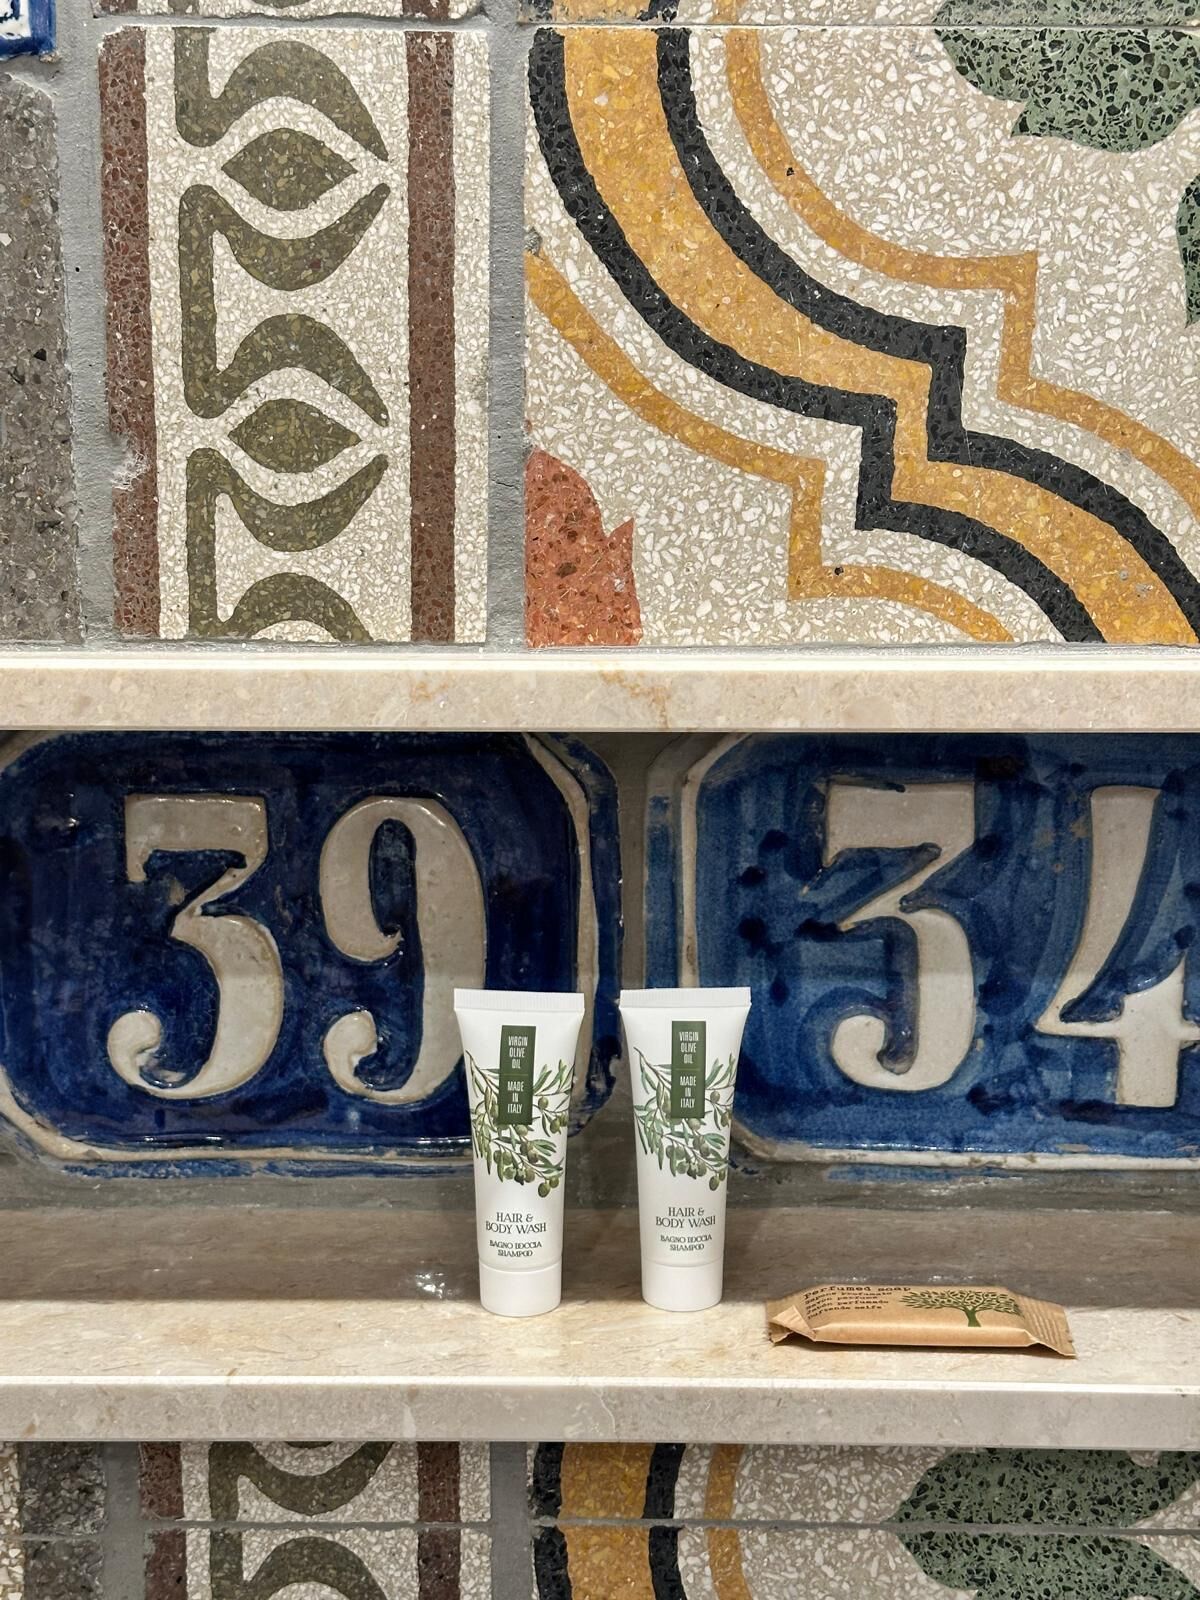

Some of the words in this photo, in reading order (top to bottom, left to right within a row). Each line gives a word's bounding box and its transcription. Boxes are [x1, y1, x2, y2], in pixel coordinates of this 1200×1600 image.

[107, 795, 487, 1105] 39
[823, 781, 1200, 1108] 34
[508, 1035, 528, 1047] VIRGIN
[679, 1031, 699, 1042] VIRGIN
[509, 1047, 526, 1058] OLIVE
[680, 1042, 697, 1053] OLIVE
[511, 1058, 521, 1069] OIL
[683, 1053, 694, 1064] OIL
[680, 1075, 697, 1086] MADE
[507, 1081, 524, 1092] MADE
[684, 1087, 692, 1097] IN
[512, 1092, 519, 1103] IN
[507, 1103, 523, 1114] ITALY
[680, 1098, 696, 1109] ITALY
[496, 1211, 523, 1223] HAIR
[525, 1213, 534, 1223] &
[668, 1206, 696, 1217] HAIR
[697, 1207, 705, 1216] &
[485, 1220, 513, 1234] BODY
[515, 1222, 547, 1234] WASH
[655, 1216, 685, 1228] BODY
[687, 1215, 716, 1228] WASH
[489, 1239, 514, 1249] BAGNO
[660, 1234, 686, 1243] BAGNO
[669, 1243, 705, 1251] SHAMPOO
[497, 1249, 534, 1257] SHAMPOO
